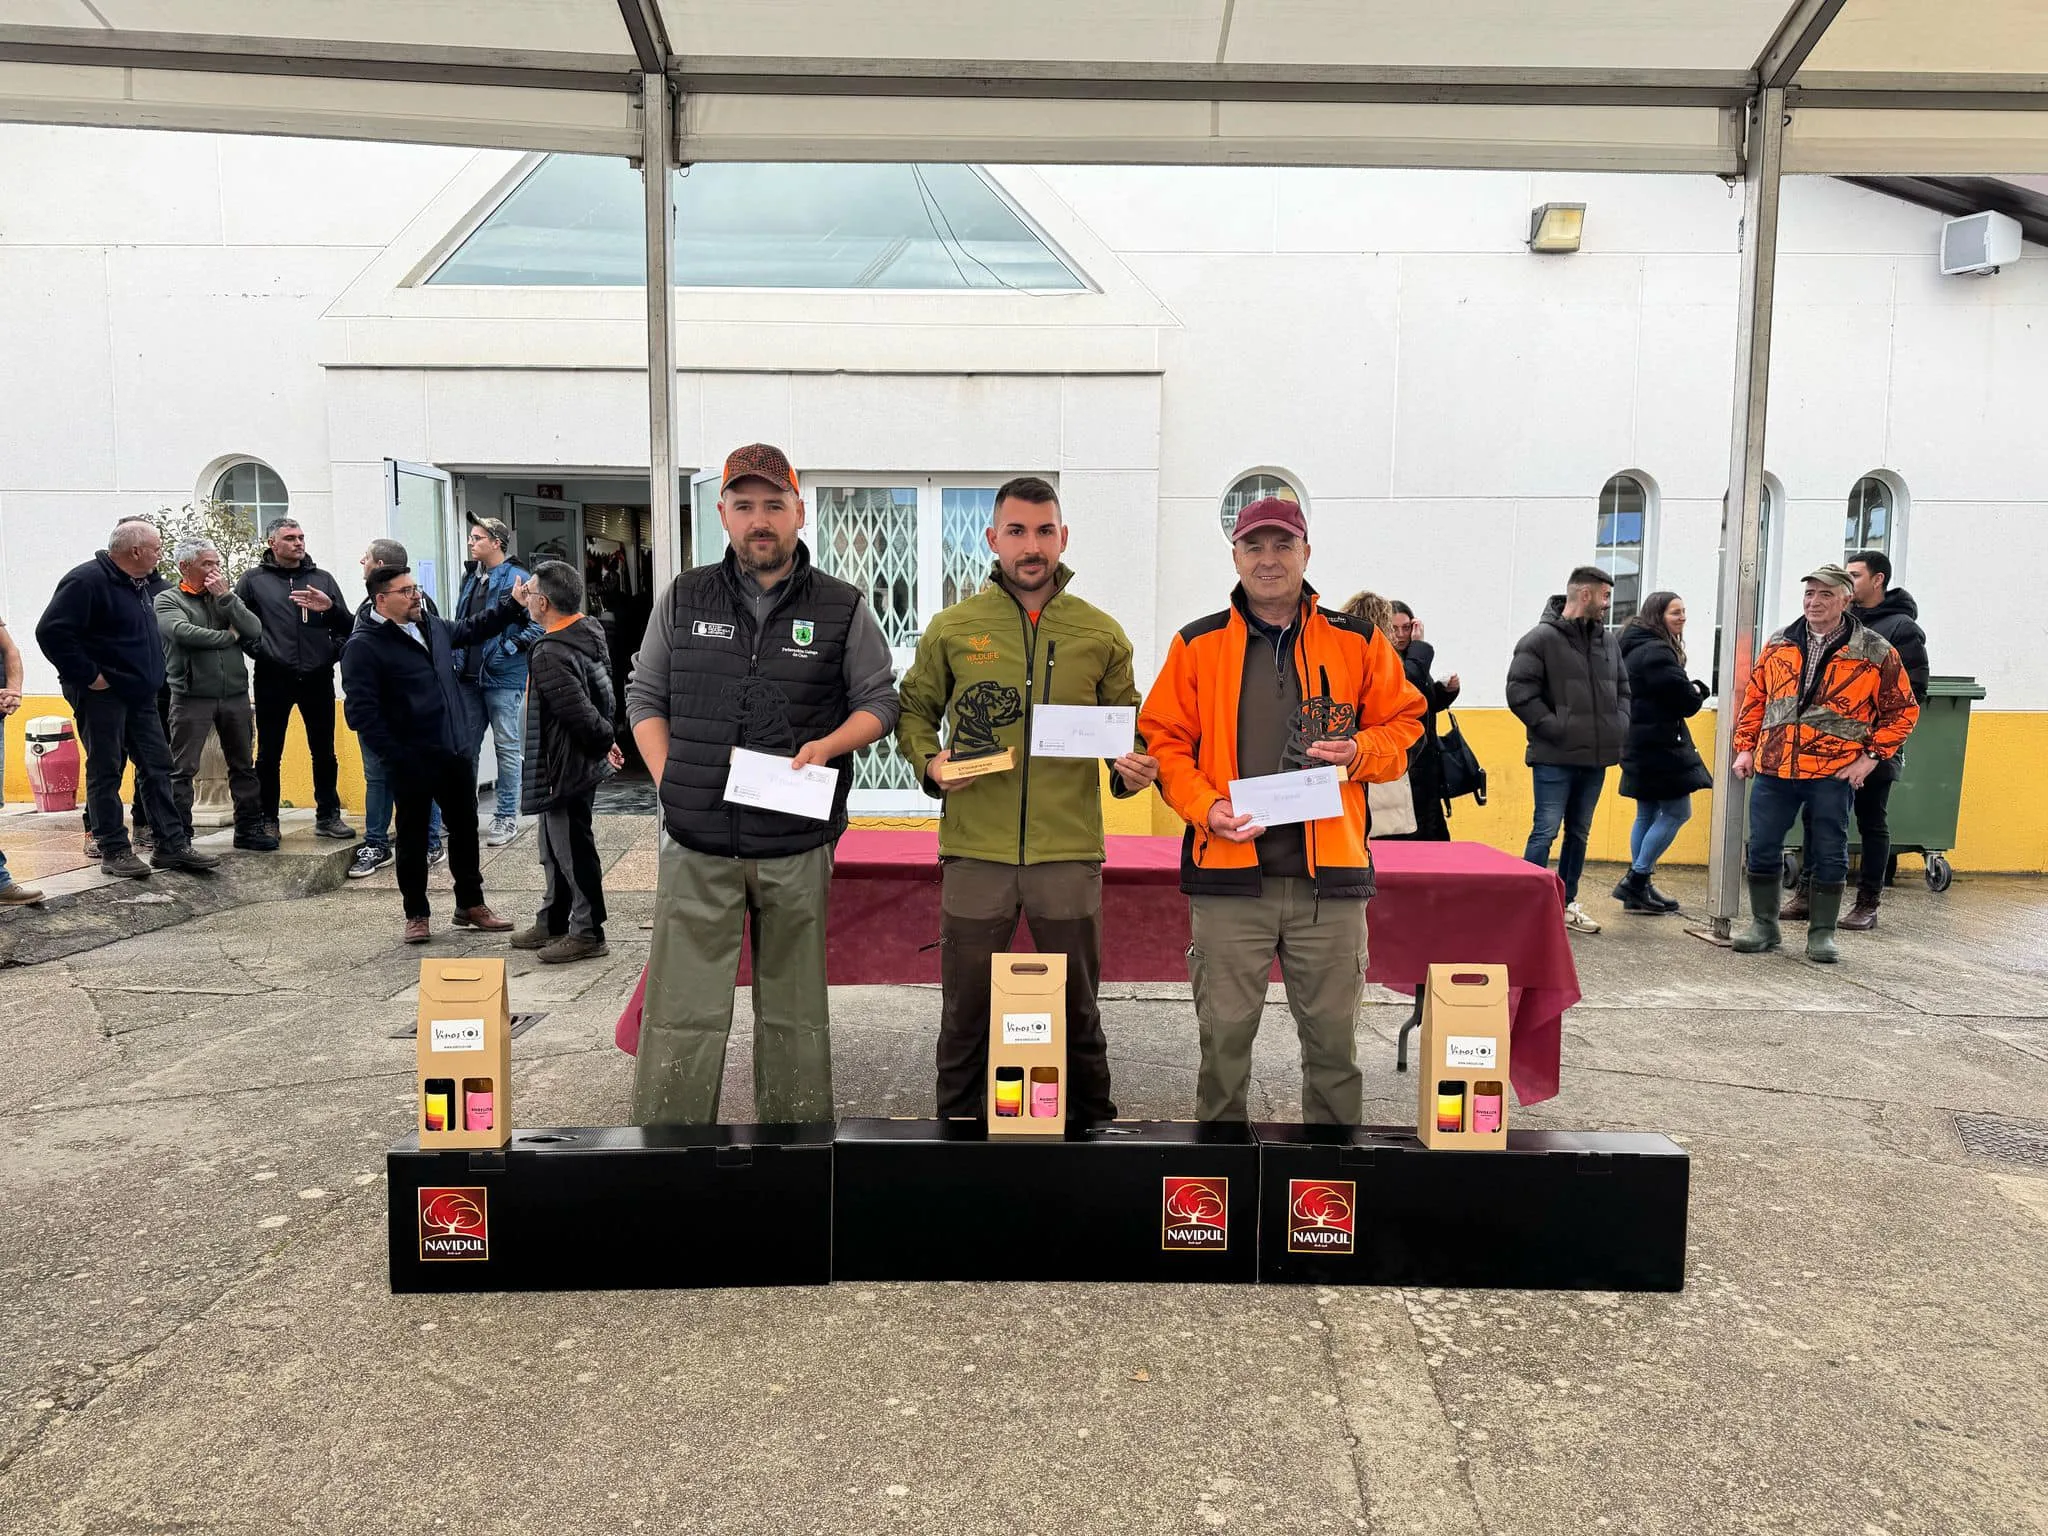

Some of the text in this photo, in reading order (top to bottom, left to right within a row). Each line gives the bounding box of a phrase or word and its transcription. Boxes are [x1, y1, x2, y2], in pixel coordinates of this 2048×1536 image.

[966, 651, 1000, 662] WILDLIFE
[435, 1028, 460, 1039] Vinos
[1450, 1043, 1474, 1055] Vinos
[1167, 1229, 1224, 1241] NAVIDUL
[1293, 1231, 1350, 1244] NAVIDUL
[425, 1239, 484, 1251] NAVIDUL
